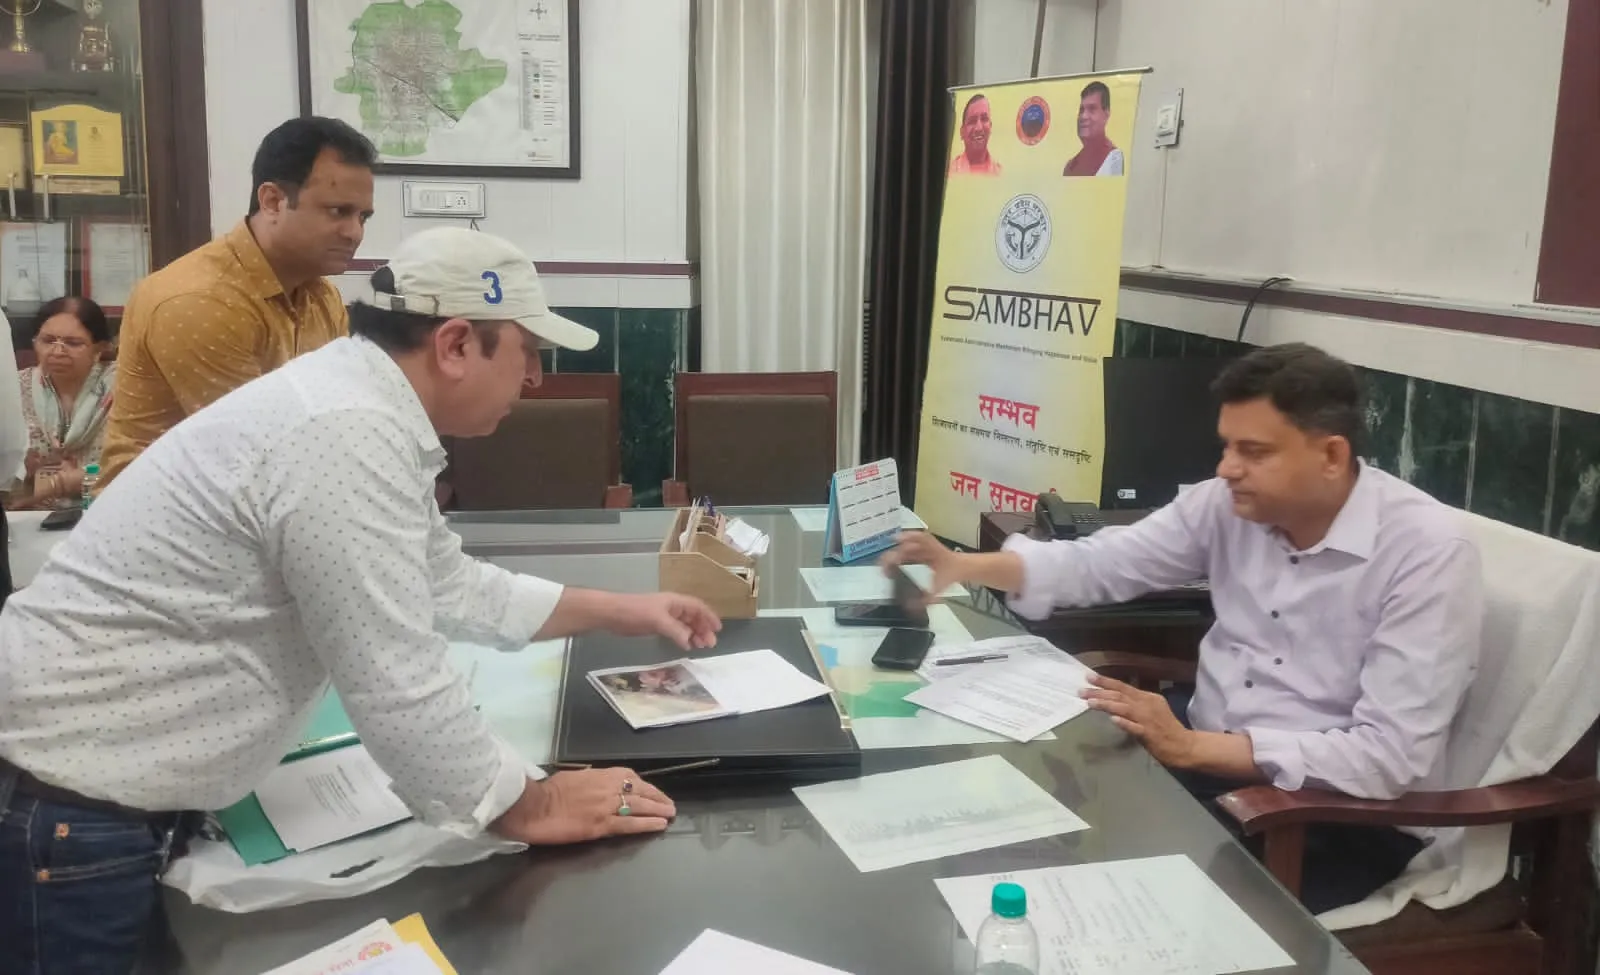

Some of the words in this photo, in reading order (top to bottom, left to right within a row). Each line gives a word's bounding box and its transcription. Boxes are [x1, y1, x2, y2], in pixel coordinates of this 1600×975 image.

[481, 270, 503, 305] 3
[943, 286, 1101, 336] SAMBHAV
[979, 395, 1040, 431] सम्भव
[950, 471, 981, 500] जन
